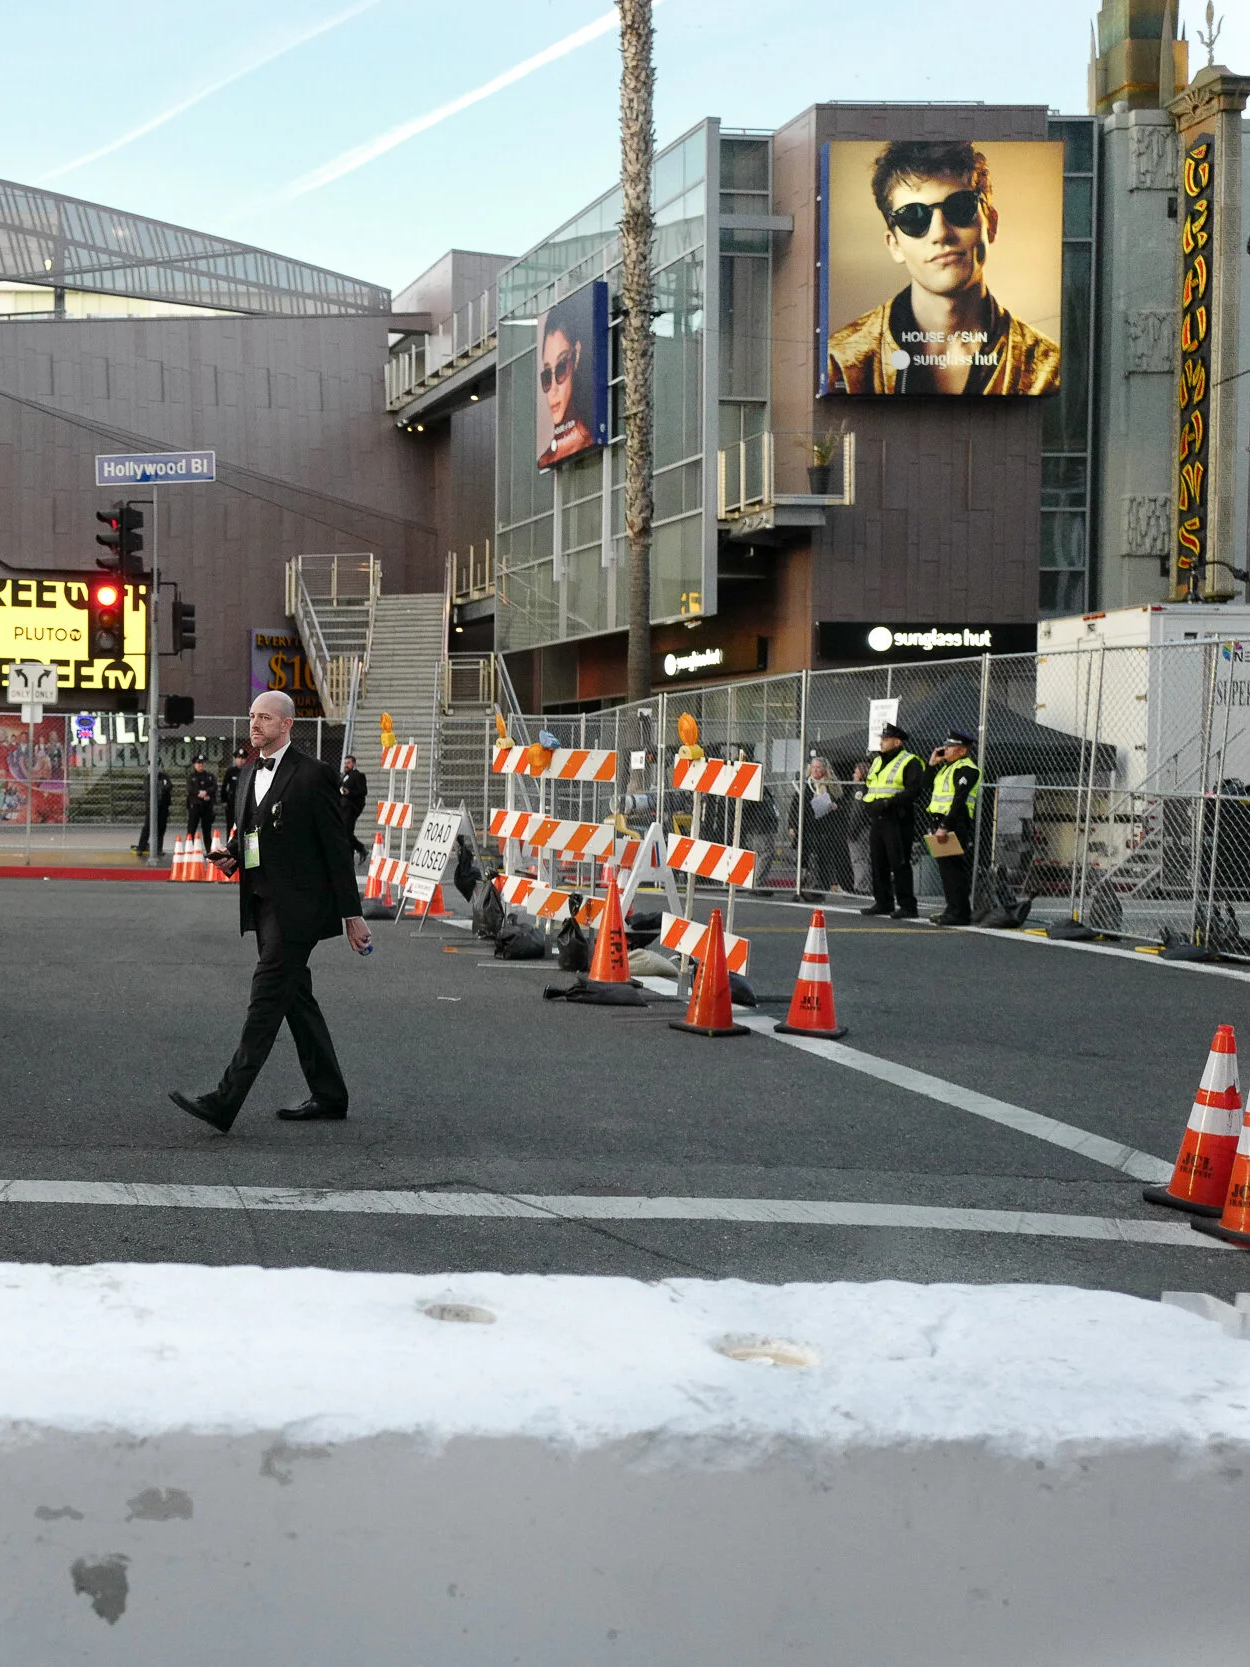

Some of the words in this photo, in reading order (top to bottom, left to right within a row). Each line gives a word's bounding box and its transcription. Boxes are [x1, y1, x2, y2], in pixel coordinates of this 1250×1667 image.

[901, 331, 945, 343] HOUSE
[961, 331, 988, 343] SUN
[913, 352, 974, 370] sunglass
[974, 351, 998, 366] hut
[103, 459, 187, 480] Hollywood
[14, 627, 68, 642] PLUTO
[893, 628, 963, 651] sunglass
[963, 628, 992, 647] hut
[11, 690, 30, 698] ONLY
[35, 690, 54, 698] ONLY
[424, 822, 451, 843] ROAD
[410, 848, 447, 871] CLOSED
[1182, 1151, 1213, 1172] JCL
